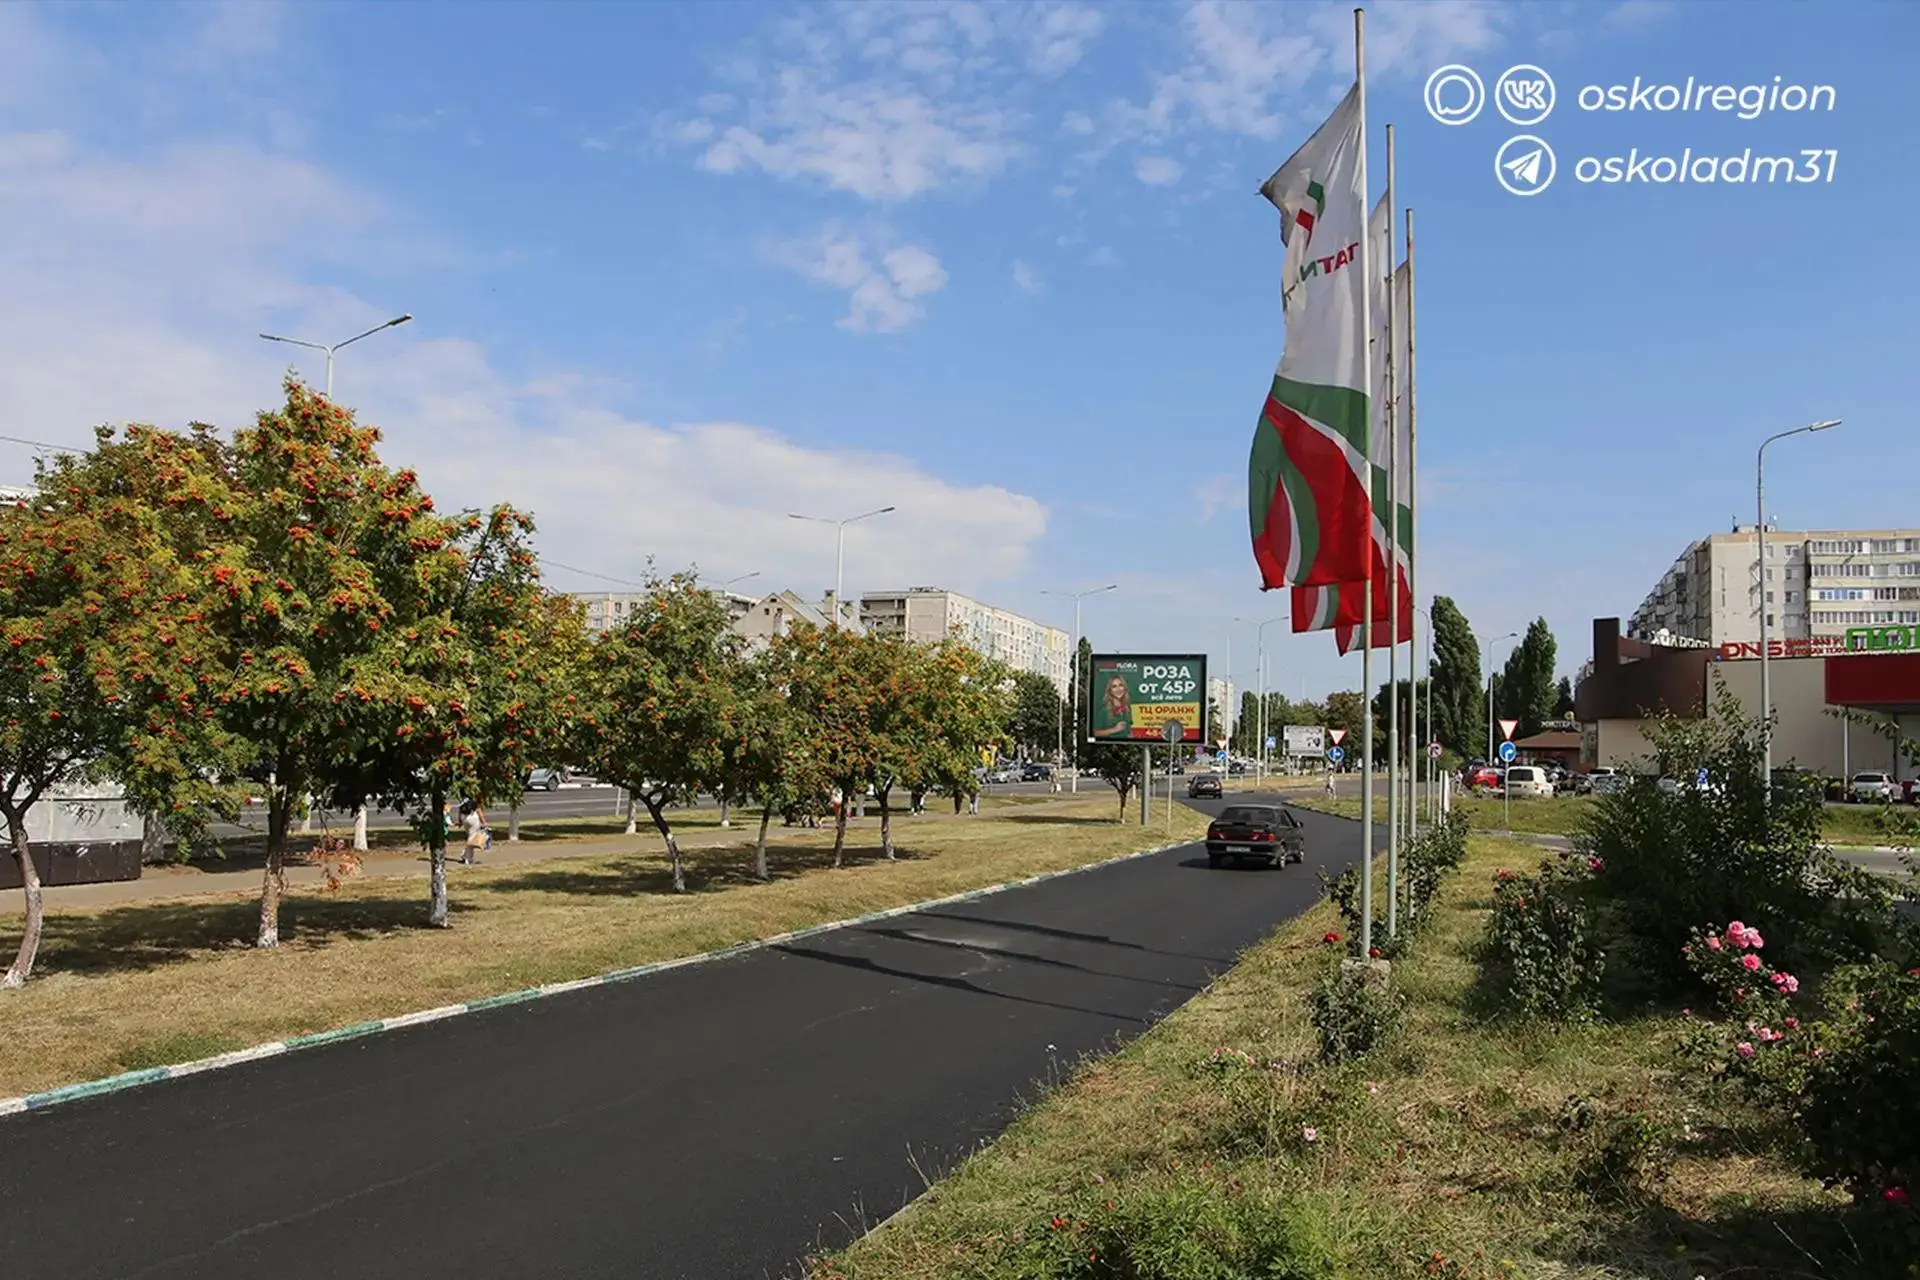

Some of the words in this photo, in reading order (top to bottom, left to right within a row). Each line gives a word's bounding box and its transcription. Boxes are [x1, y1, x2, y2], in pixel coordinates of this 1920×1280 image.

[1720, 641, 1783, 657] DNS
[1143, 665, 1191, 679] РОЗА
[1139, 706, 1153, 714] ТЦ
[1155, 706, 1195, 714] ОРАНЖ
